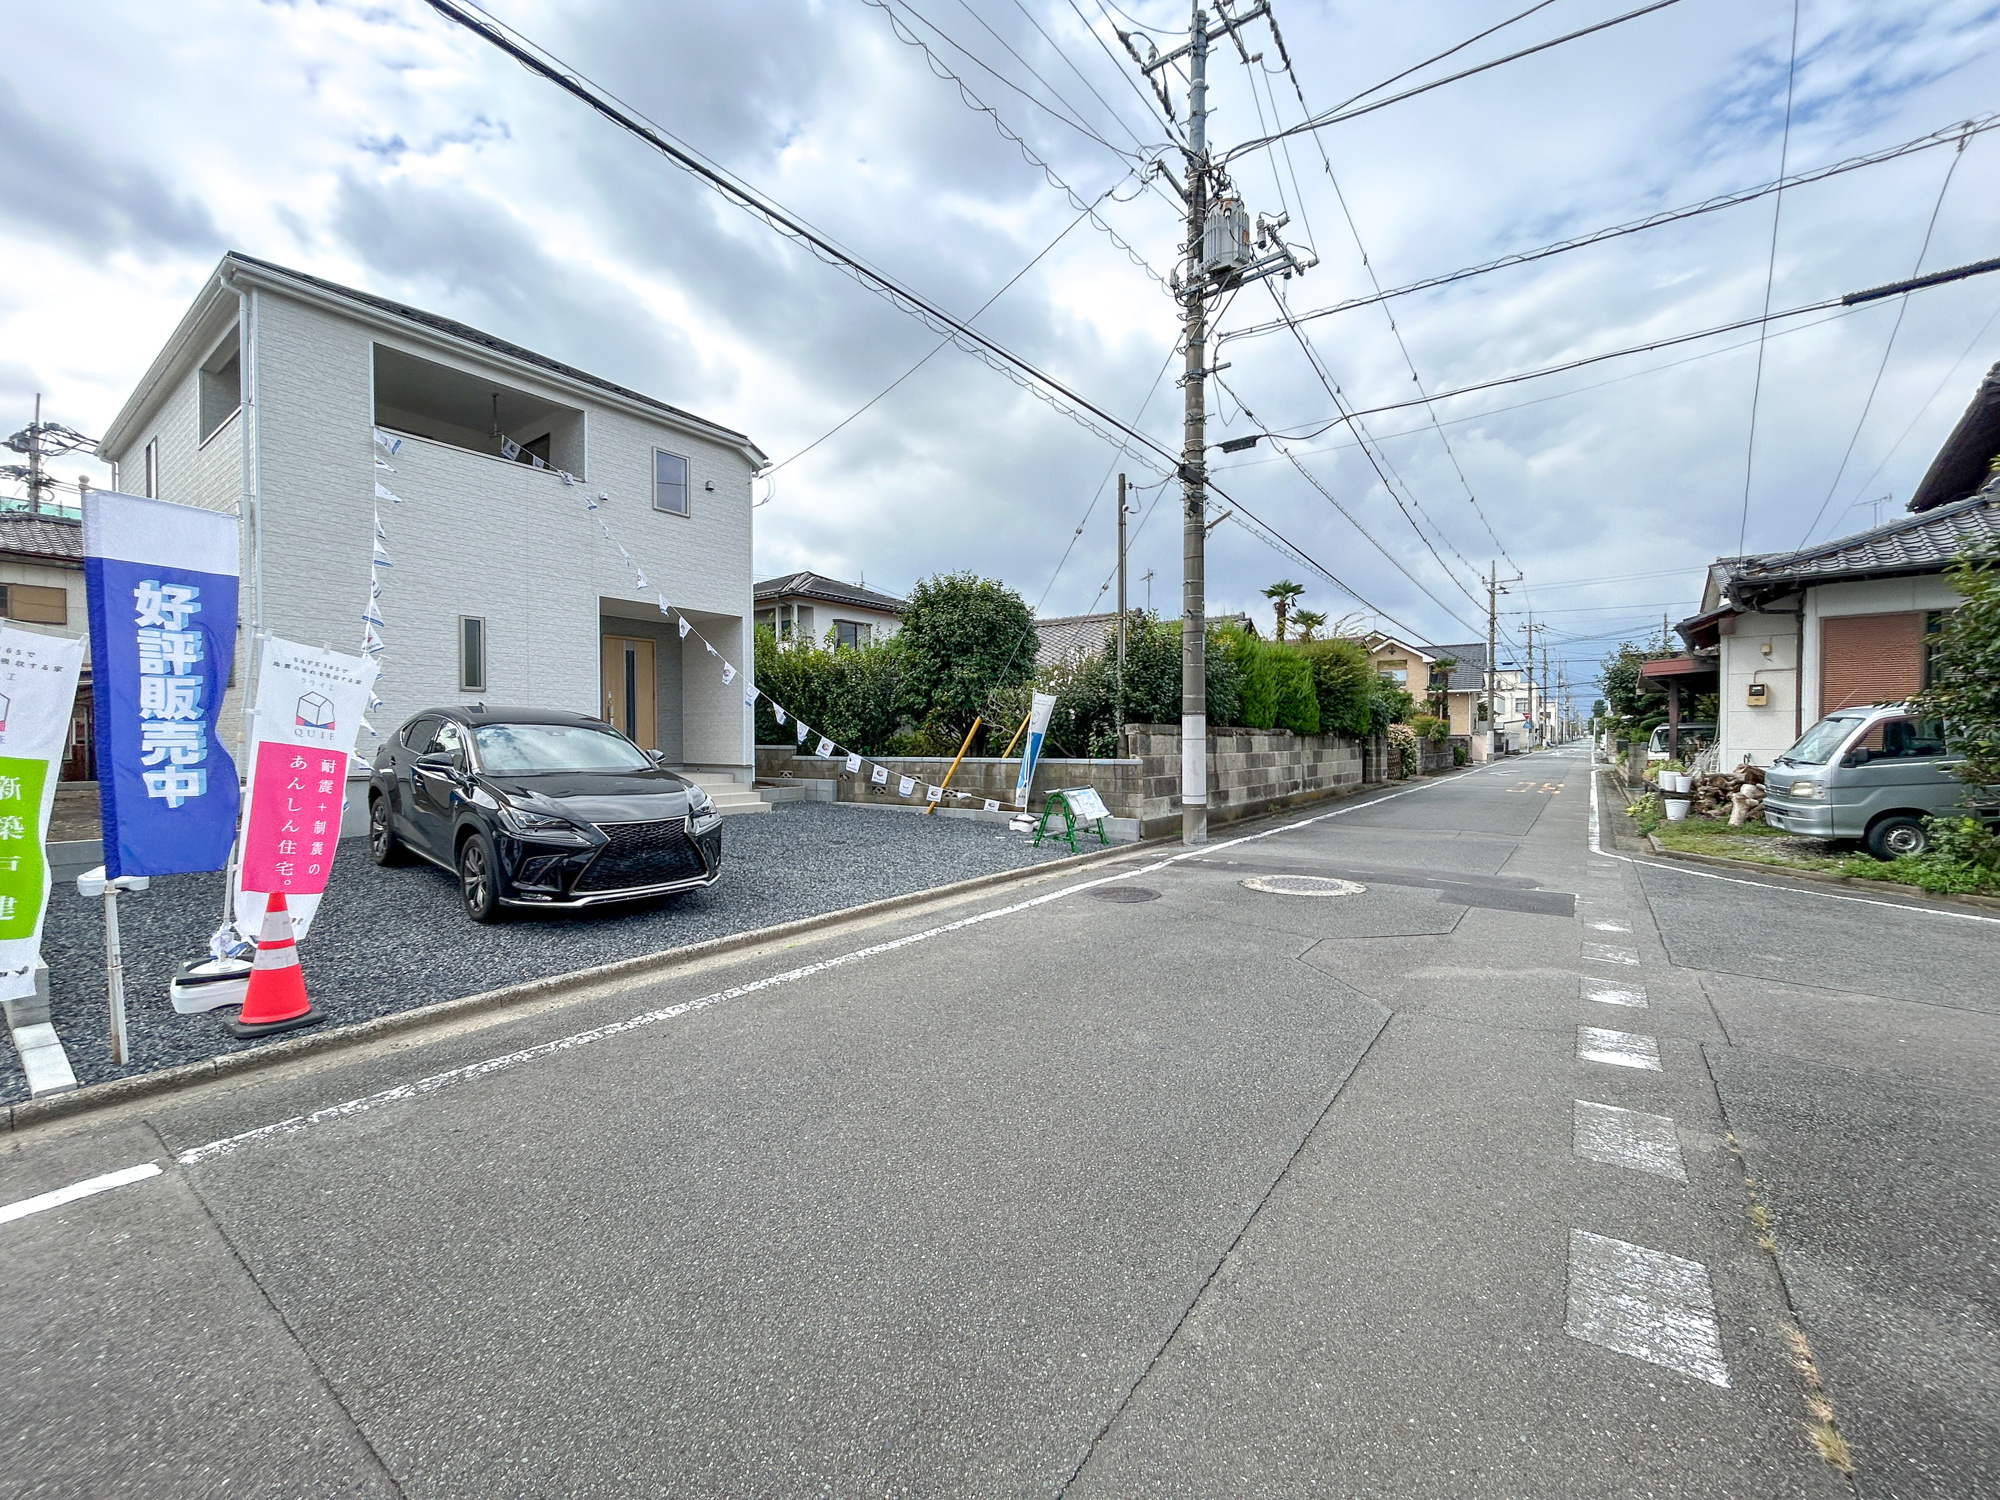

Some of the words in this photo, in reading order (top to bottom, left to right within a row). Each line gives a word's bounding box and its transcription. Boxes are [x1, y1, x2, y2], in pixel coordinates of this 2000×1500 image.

[134, 579, 208, 809] 好評販売中
[294, 728, 335, 740] QUIE
[275, 755, 307, 886] あんしん住宅。
